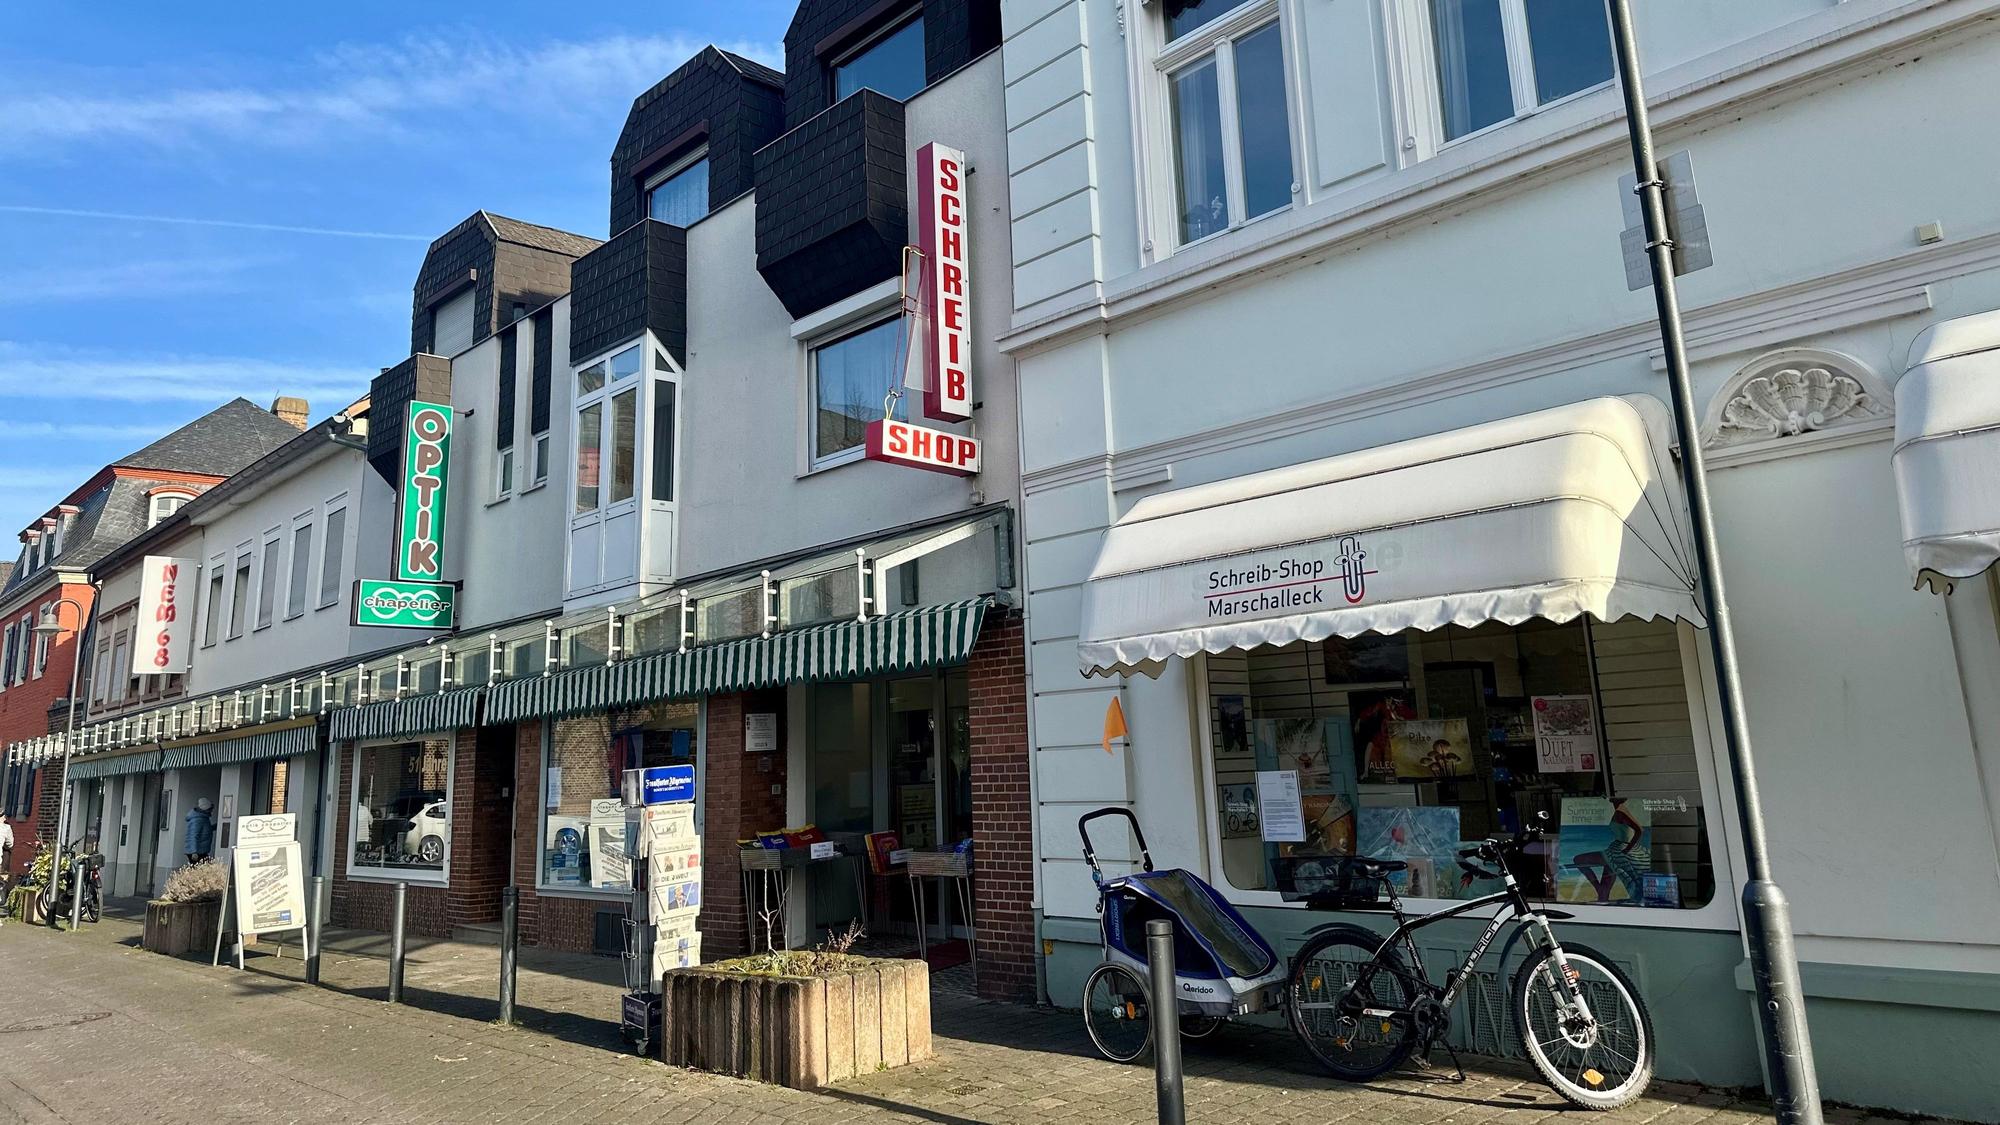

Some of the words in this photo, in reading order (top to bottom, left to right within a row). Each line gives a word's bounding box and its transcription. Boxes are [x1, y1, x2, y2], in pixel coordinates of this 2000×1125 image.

[940, 158, 965, 401] SCHREIB
[889, 424, 976, 467] SHOP
[408, 408, 449, 575] OPTIK
[1208, 559, 1324, 589] Schreib-Shop
[364, 593, 451, 612] chapelier
[1208, 585, 1323, 617] Marschalleck
[1541, 737, 1574, 757] DUFT
[1567, 805, 1605, 815] Summer
[1183, 983, 1214, 994] Qeridoo
